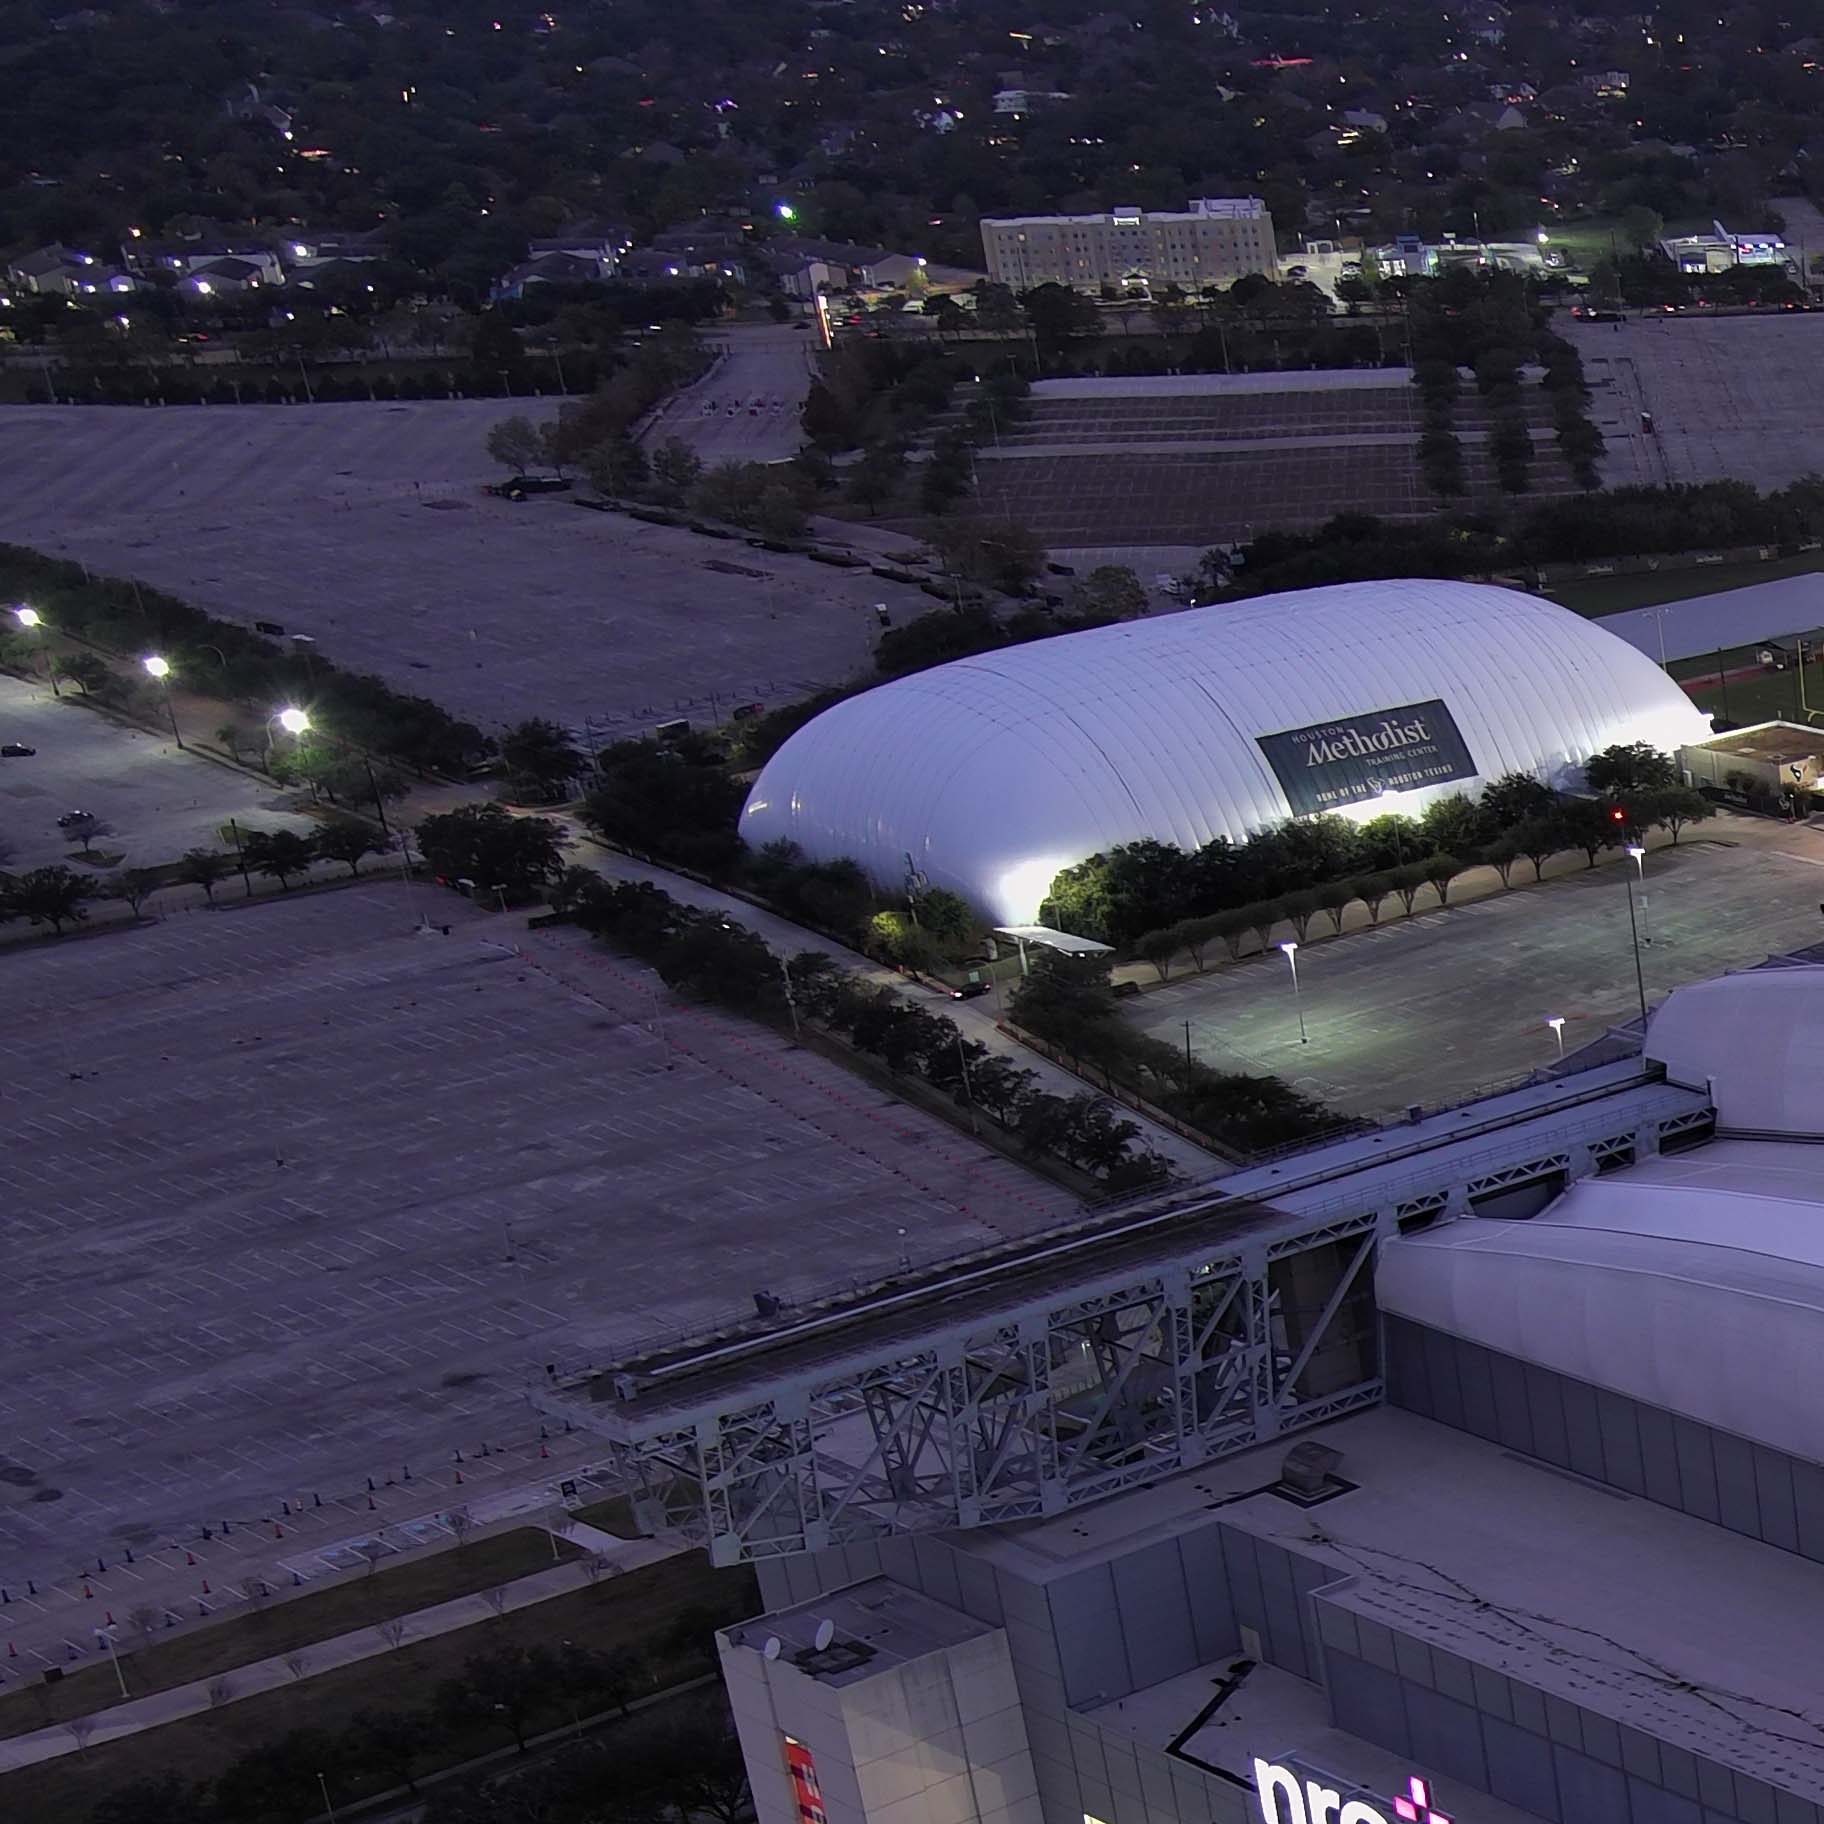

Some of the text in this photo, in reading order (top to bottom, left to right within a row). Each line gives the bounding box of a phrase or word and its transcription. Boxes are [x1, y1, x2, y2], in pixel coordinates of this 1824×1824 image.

[1291, 726, 1345, 745] HOUSTON
[1306, 719, 1431, 767] Methodist
[1366, 744, 1439, 768] TRAINING CENTER
